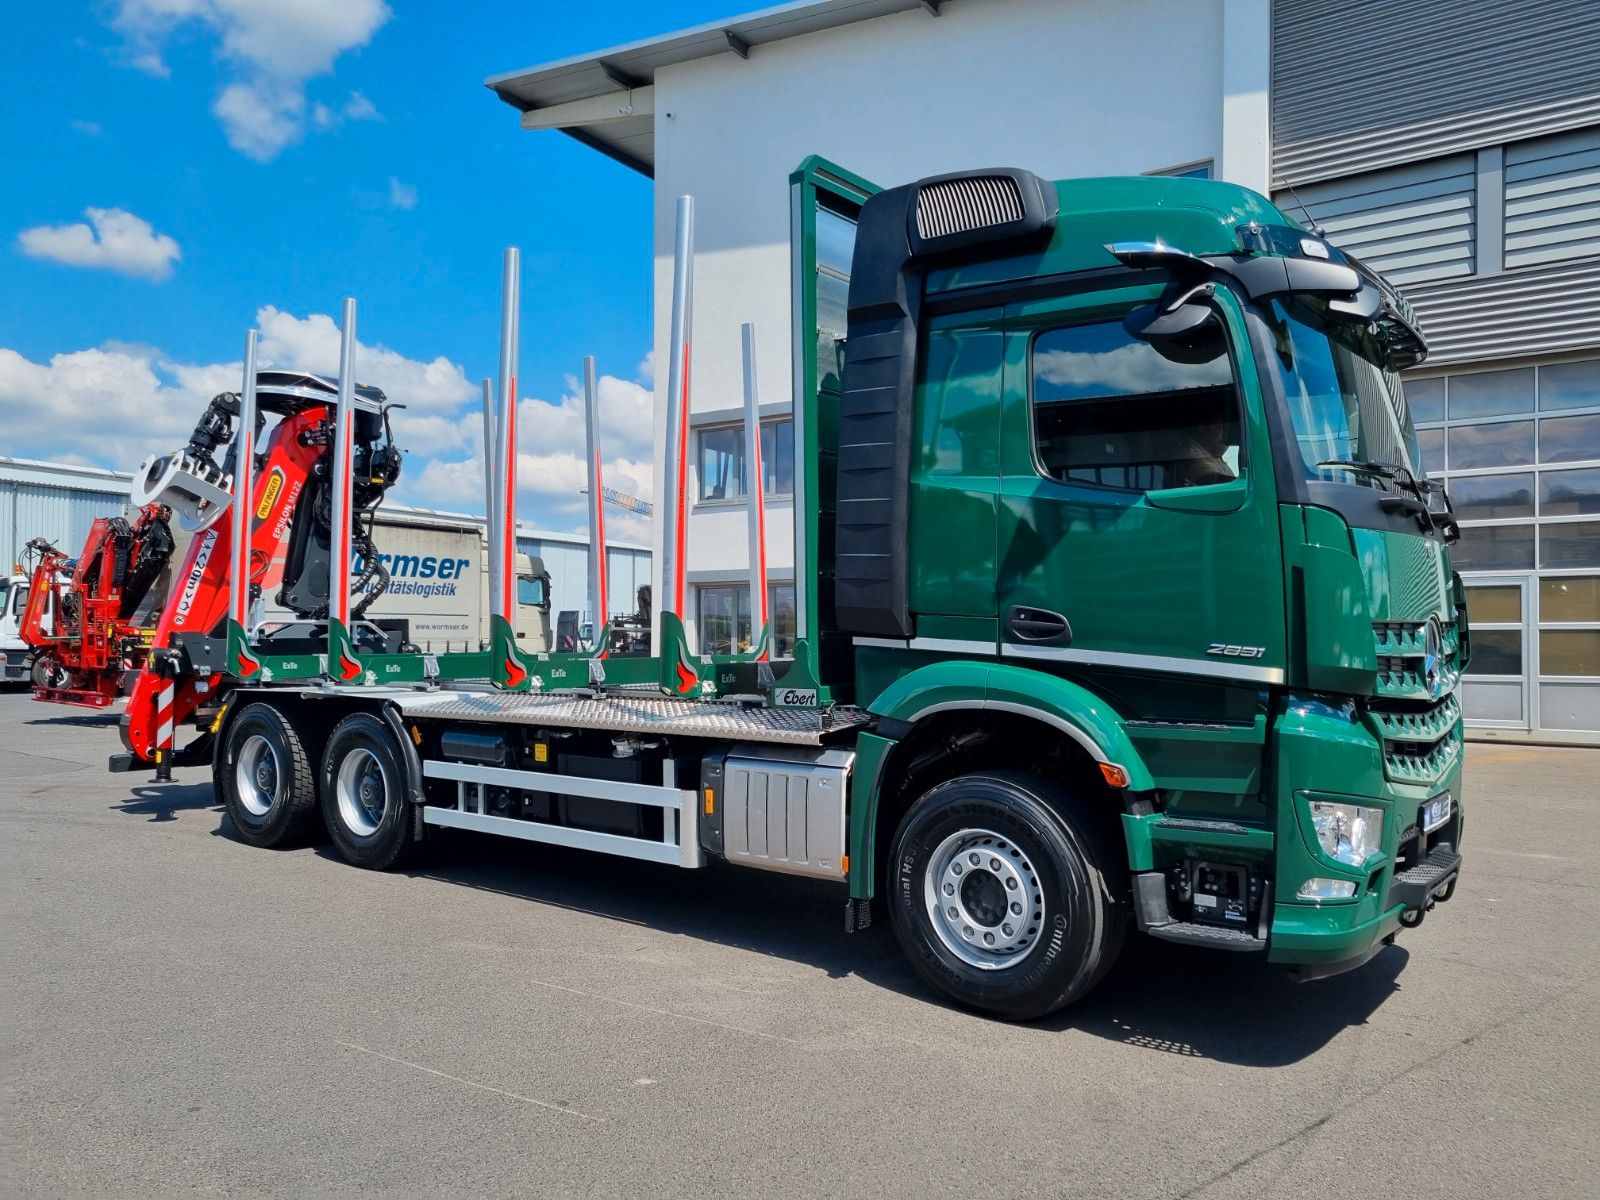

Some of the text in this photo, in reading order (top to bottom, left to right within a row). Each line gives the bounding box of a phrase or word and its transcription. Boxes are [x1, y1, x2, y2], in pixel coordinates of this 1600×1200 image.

[260, 478, 279, 516] PALFINGER
[272, 504, 292, 539] EPSILON
[351, 546, 470, 579] ormser
[282, 662, 298, 670] ExTe
[385, 664, 401, 672] ExTe
[551, 669, 567, 678] ExTe
[721, 673, 737, 683] ExTe
[784, 690, 815, 705] Ebert
